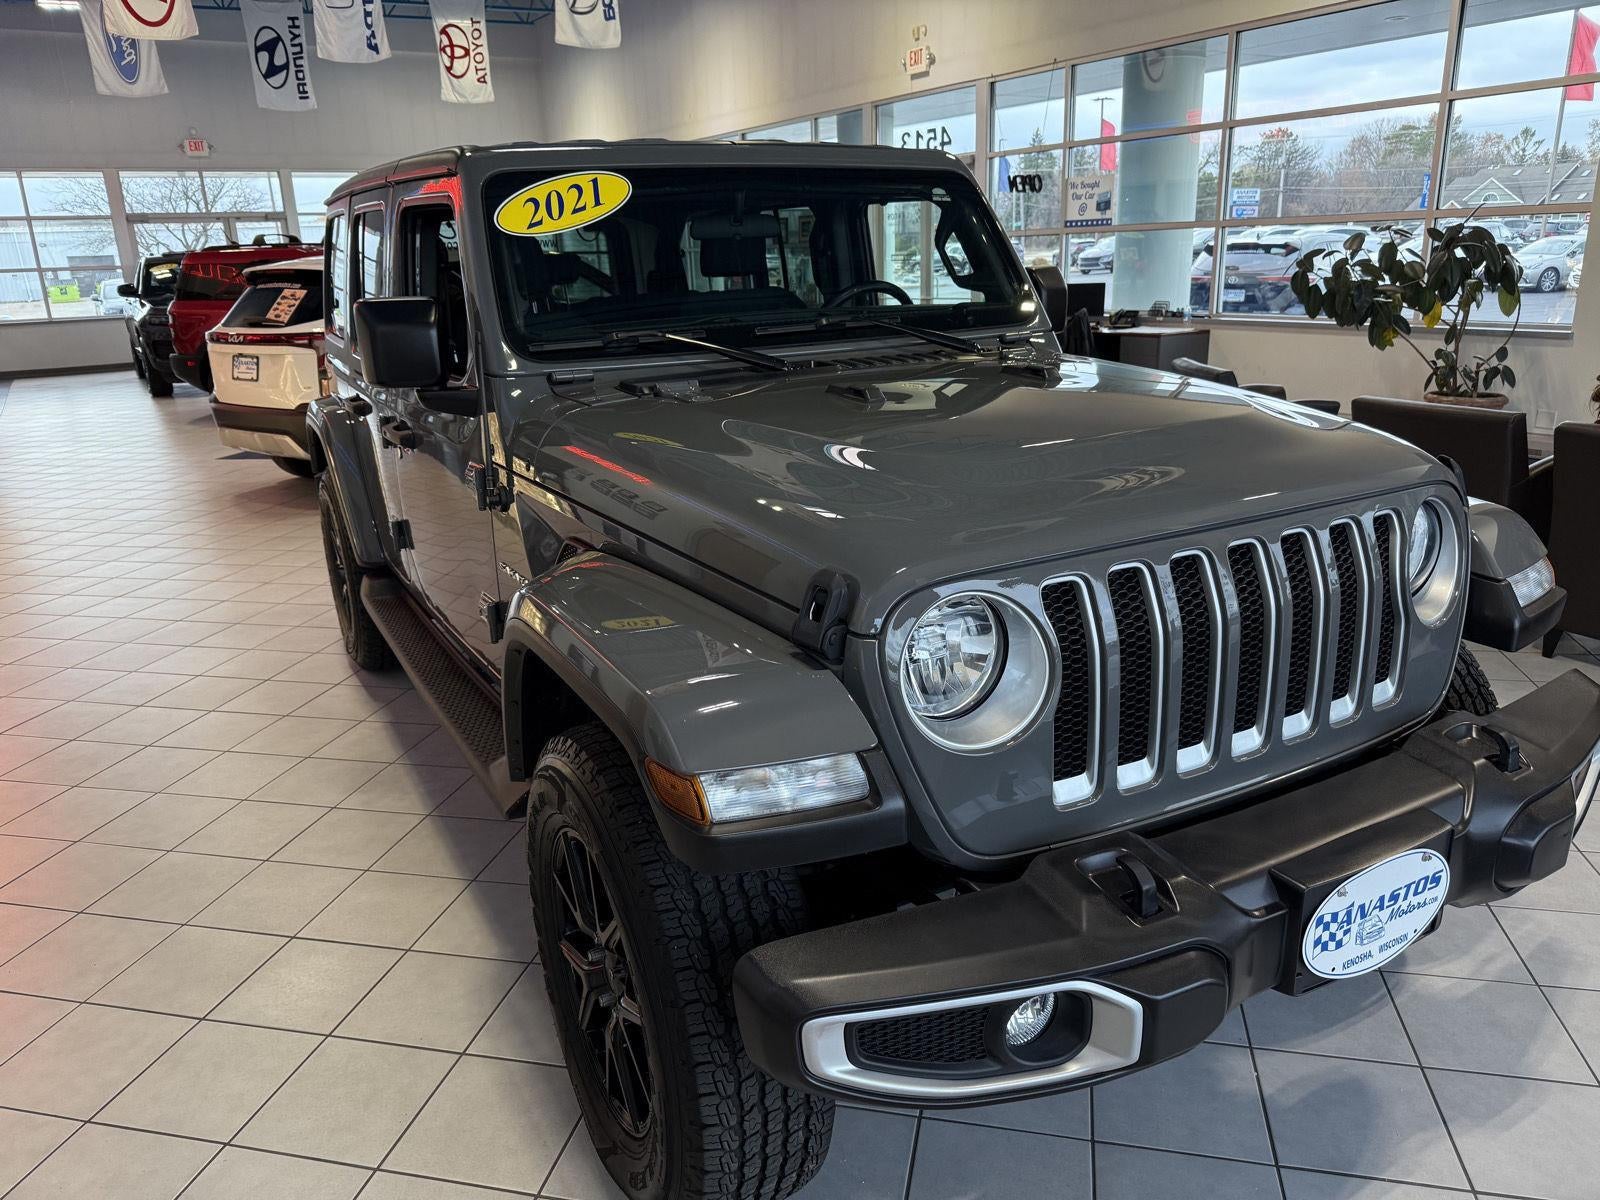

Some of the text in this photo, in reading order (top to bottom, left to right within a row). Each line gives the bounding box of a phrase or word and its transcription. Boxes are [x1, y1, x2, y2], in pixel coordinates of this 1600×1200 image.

[909, 48, 923, 67] EXIT
[188, 140, 204, 152] EXIT
[523, 176, 606, 230] 2021
[1336, 869, 1444, 931] ANASTOS
[1342, 932, 1409, 971] KENOSHA, WISCONSIN
